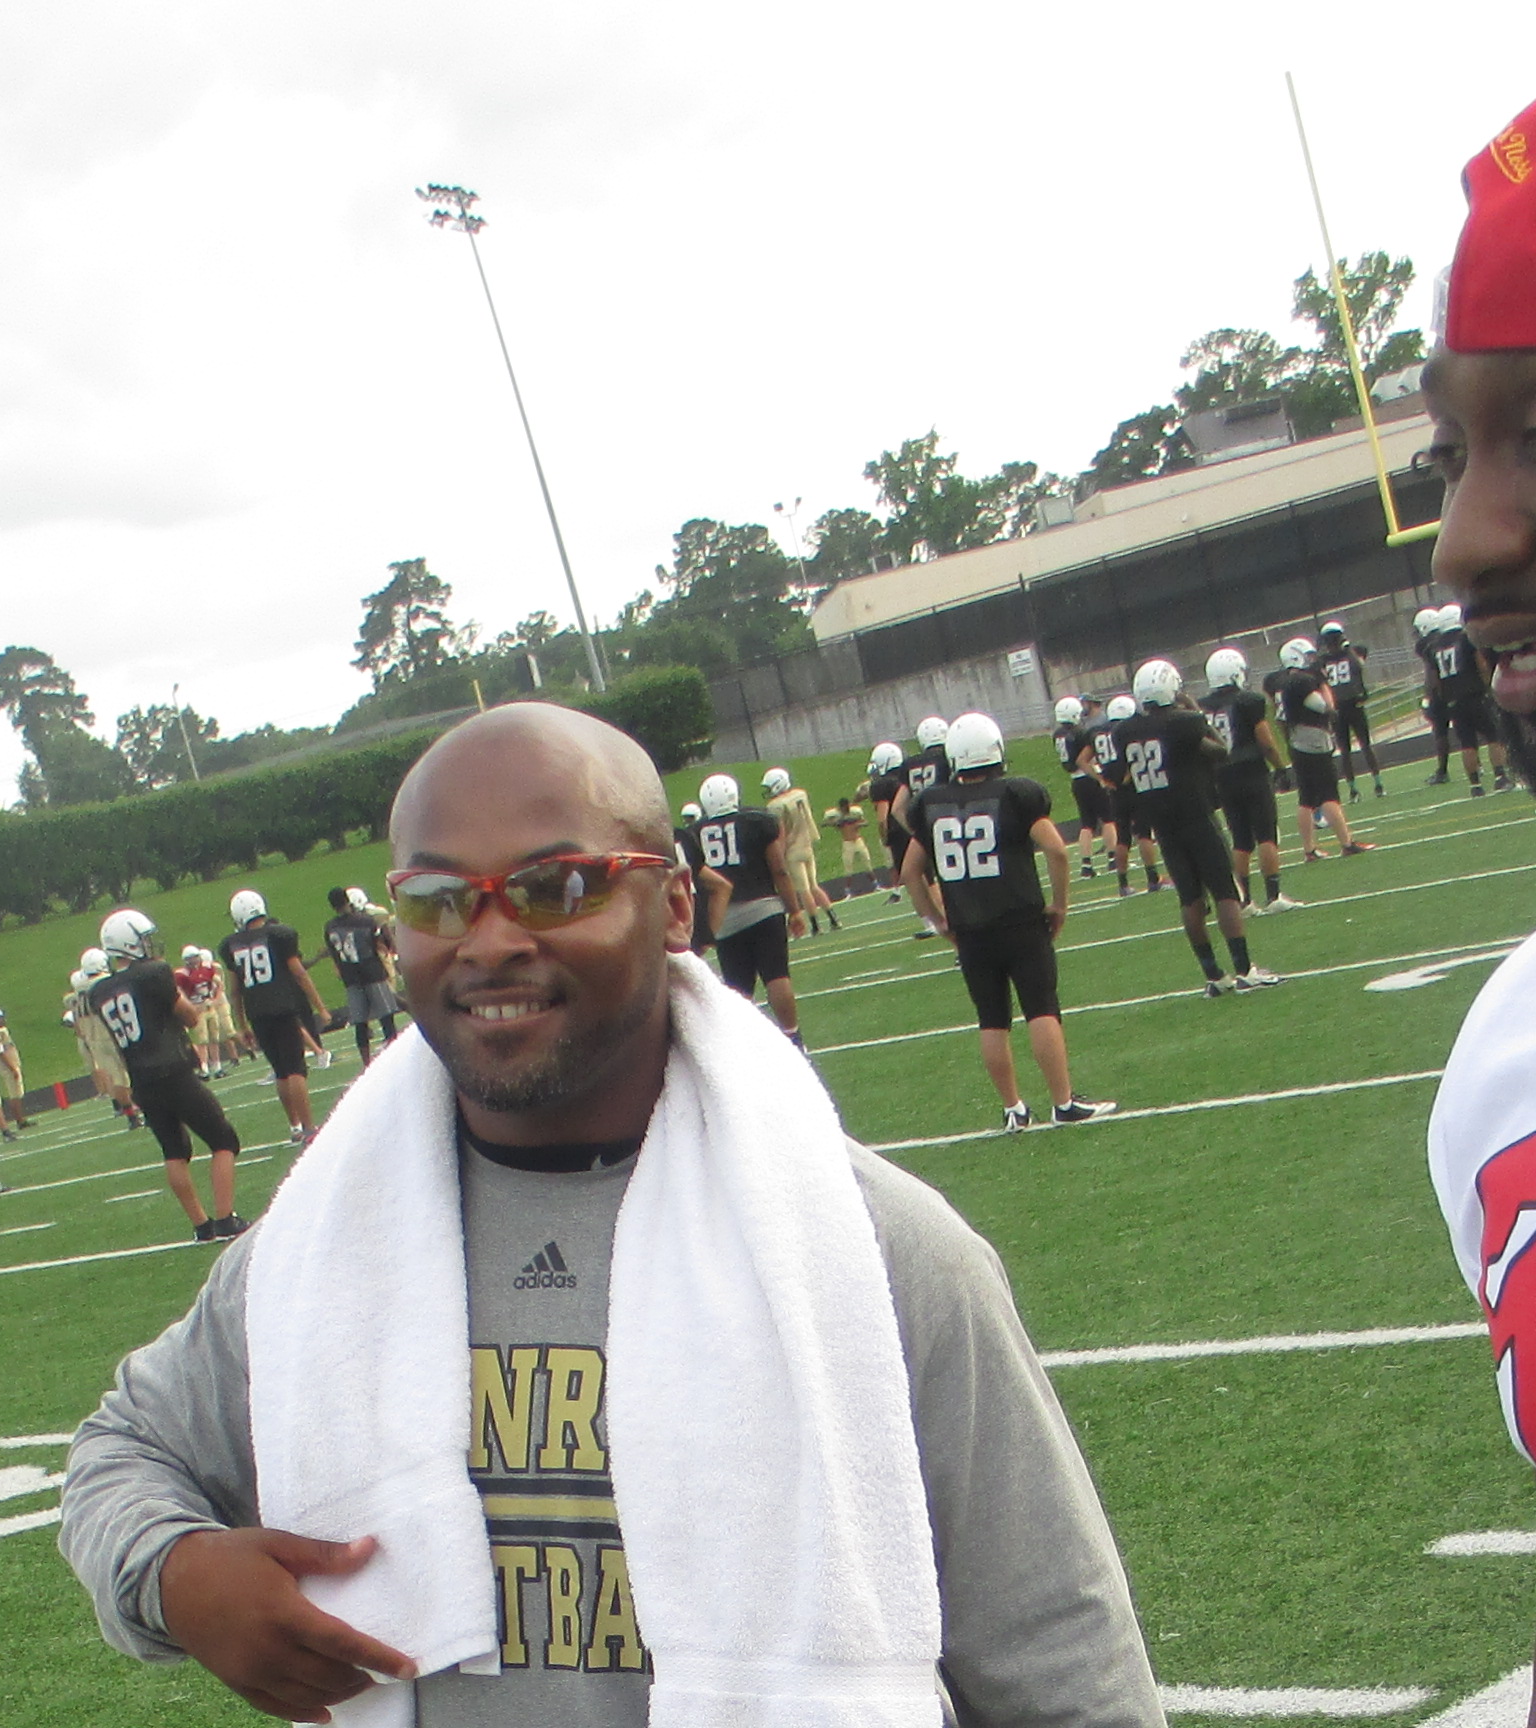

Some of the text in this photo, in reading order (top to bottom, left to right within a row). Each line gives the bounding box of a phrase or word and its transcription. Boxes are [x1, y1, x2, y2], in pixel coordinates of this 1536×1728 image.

[1435, 647, 1458, 680] 17
[1094, 734, 1118, 765] 91
[1125, 739, 1170, 794] 22
[700, 822, 741, 868] 61
[932, 815, 1001, 882] 62
[234, 944, 275, 989] 79
[101, 992, 142, 1049] 59
[513, 1271, 578, 1290] adidas
